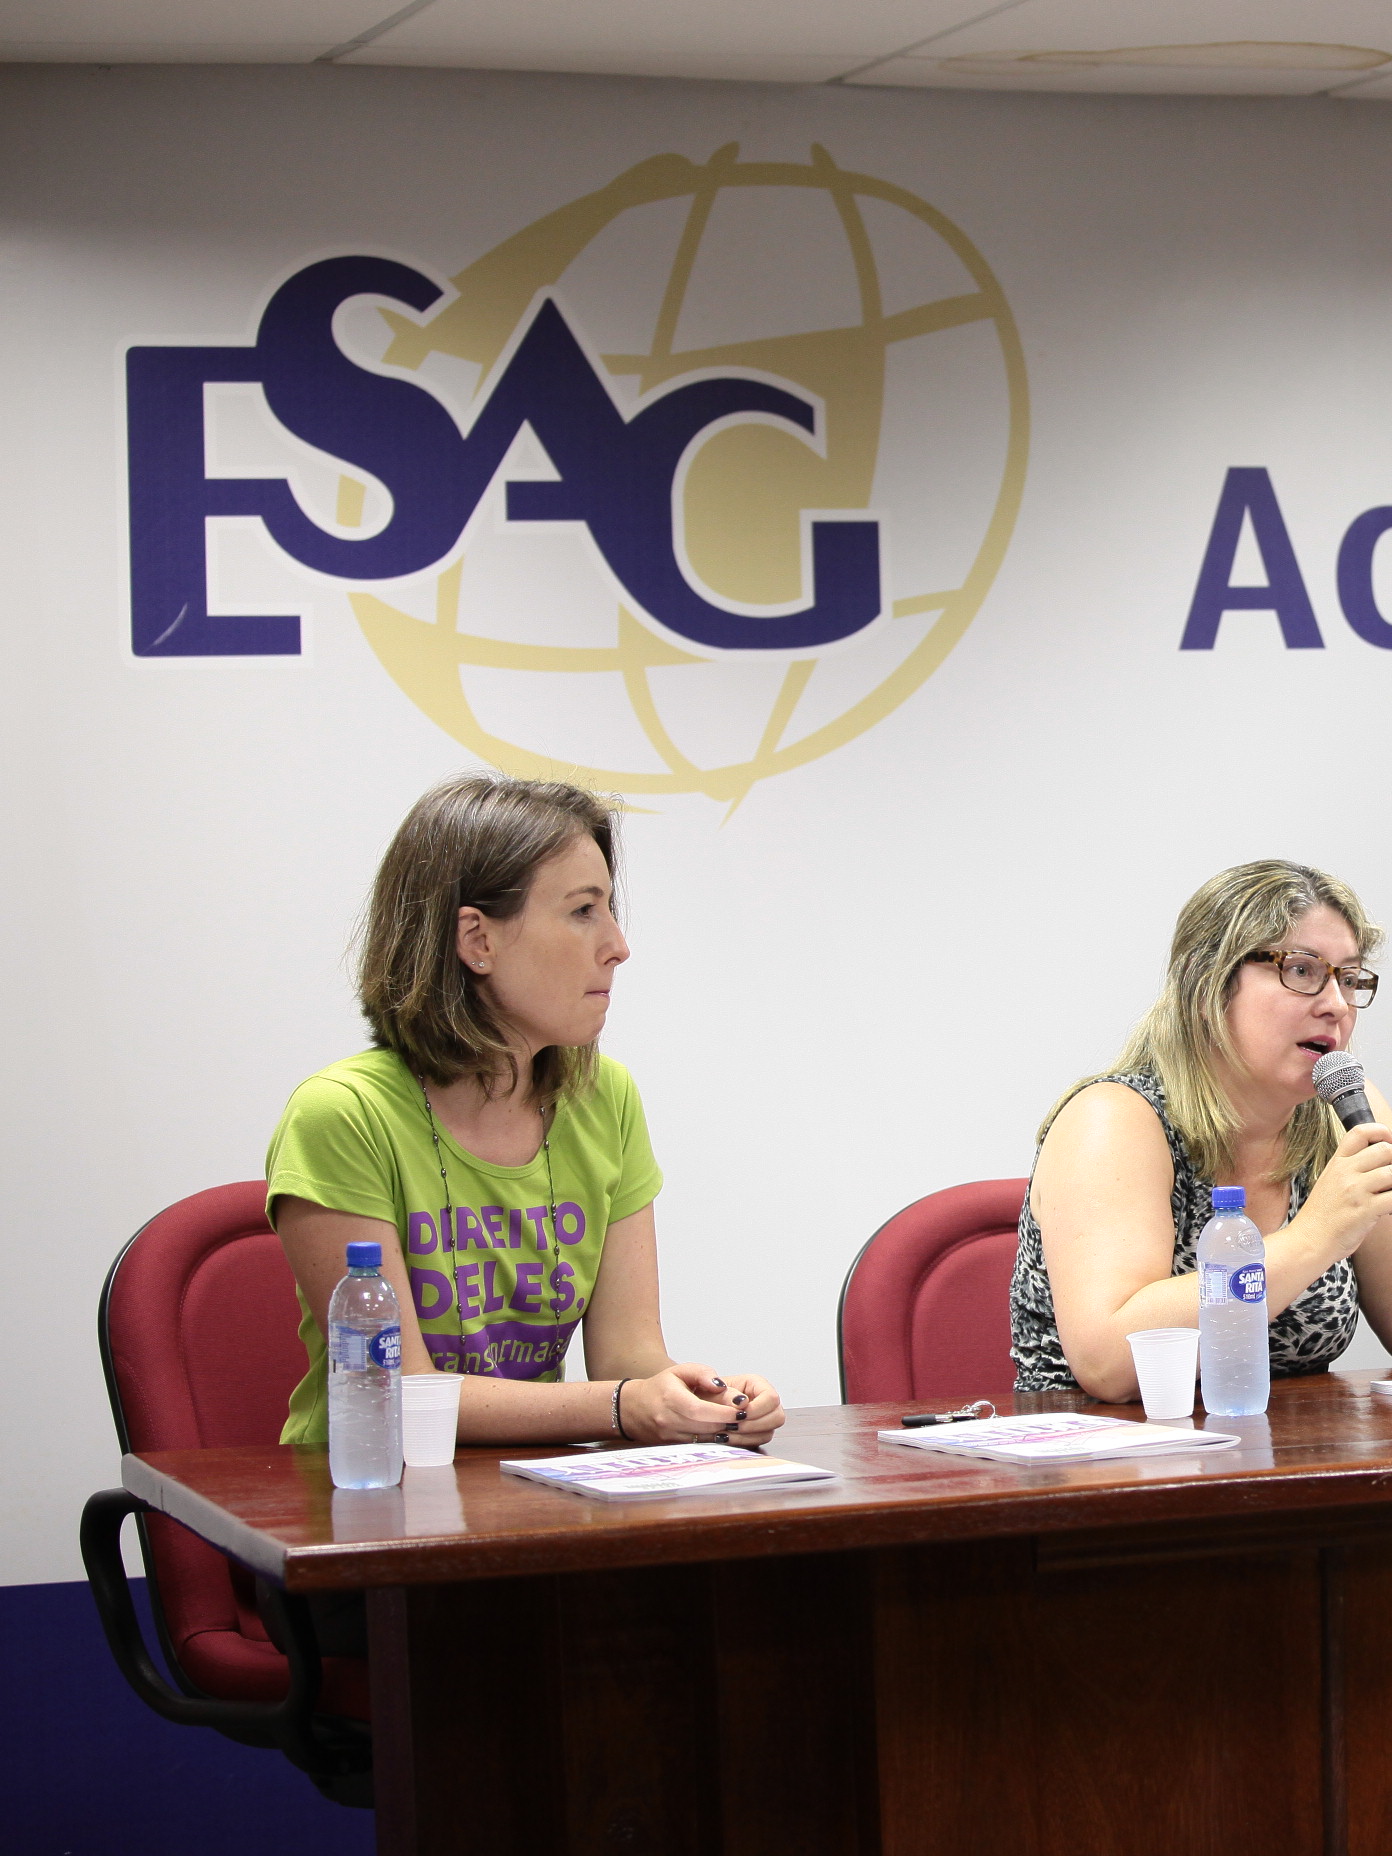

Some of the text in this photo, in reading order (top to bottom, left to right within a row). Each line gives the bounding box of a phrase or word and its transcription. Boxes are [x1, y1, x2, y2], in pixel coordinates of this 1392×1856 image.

[126, 254, 881, 657] ESAG
[407, 1201, 586, 1255] DIREITO
[410, 1260, 585, 1321] DELES,
[1238, 1271, 1264, 1285] SANTA
[1245, 1280, 1263, 1294] RITA
[378, 1335, 401, 1349] SANT
